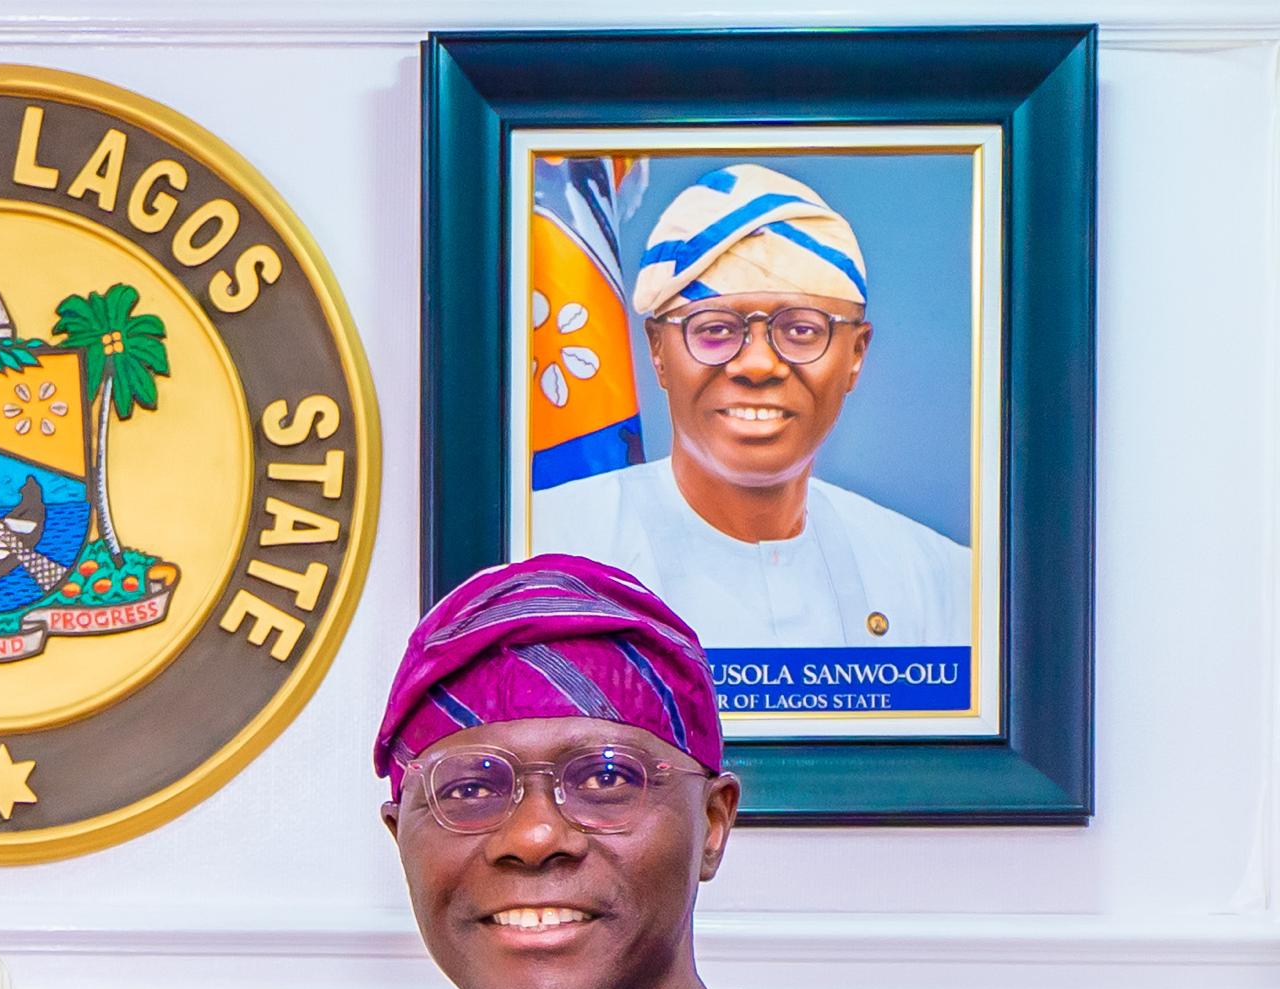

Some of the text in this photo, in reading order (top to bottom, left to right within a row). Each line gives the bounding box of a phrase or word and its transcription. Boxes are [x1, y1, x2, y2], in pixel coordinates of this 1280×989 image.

[12, 105, 283, 313] LAGOS
[219, 394, 347, 662] STATE
[50, 601, 159, 631] PROGRESS
[709, 662, 959, 686] USOLA SANWO-OLU
[733, 693, 760, 710] OF
[764, 692, 829, 710] LAGOS
[832, 692, 893, 709] STATE
